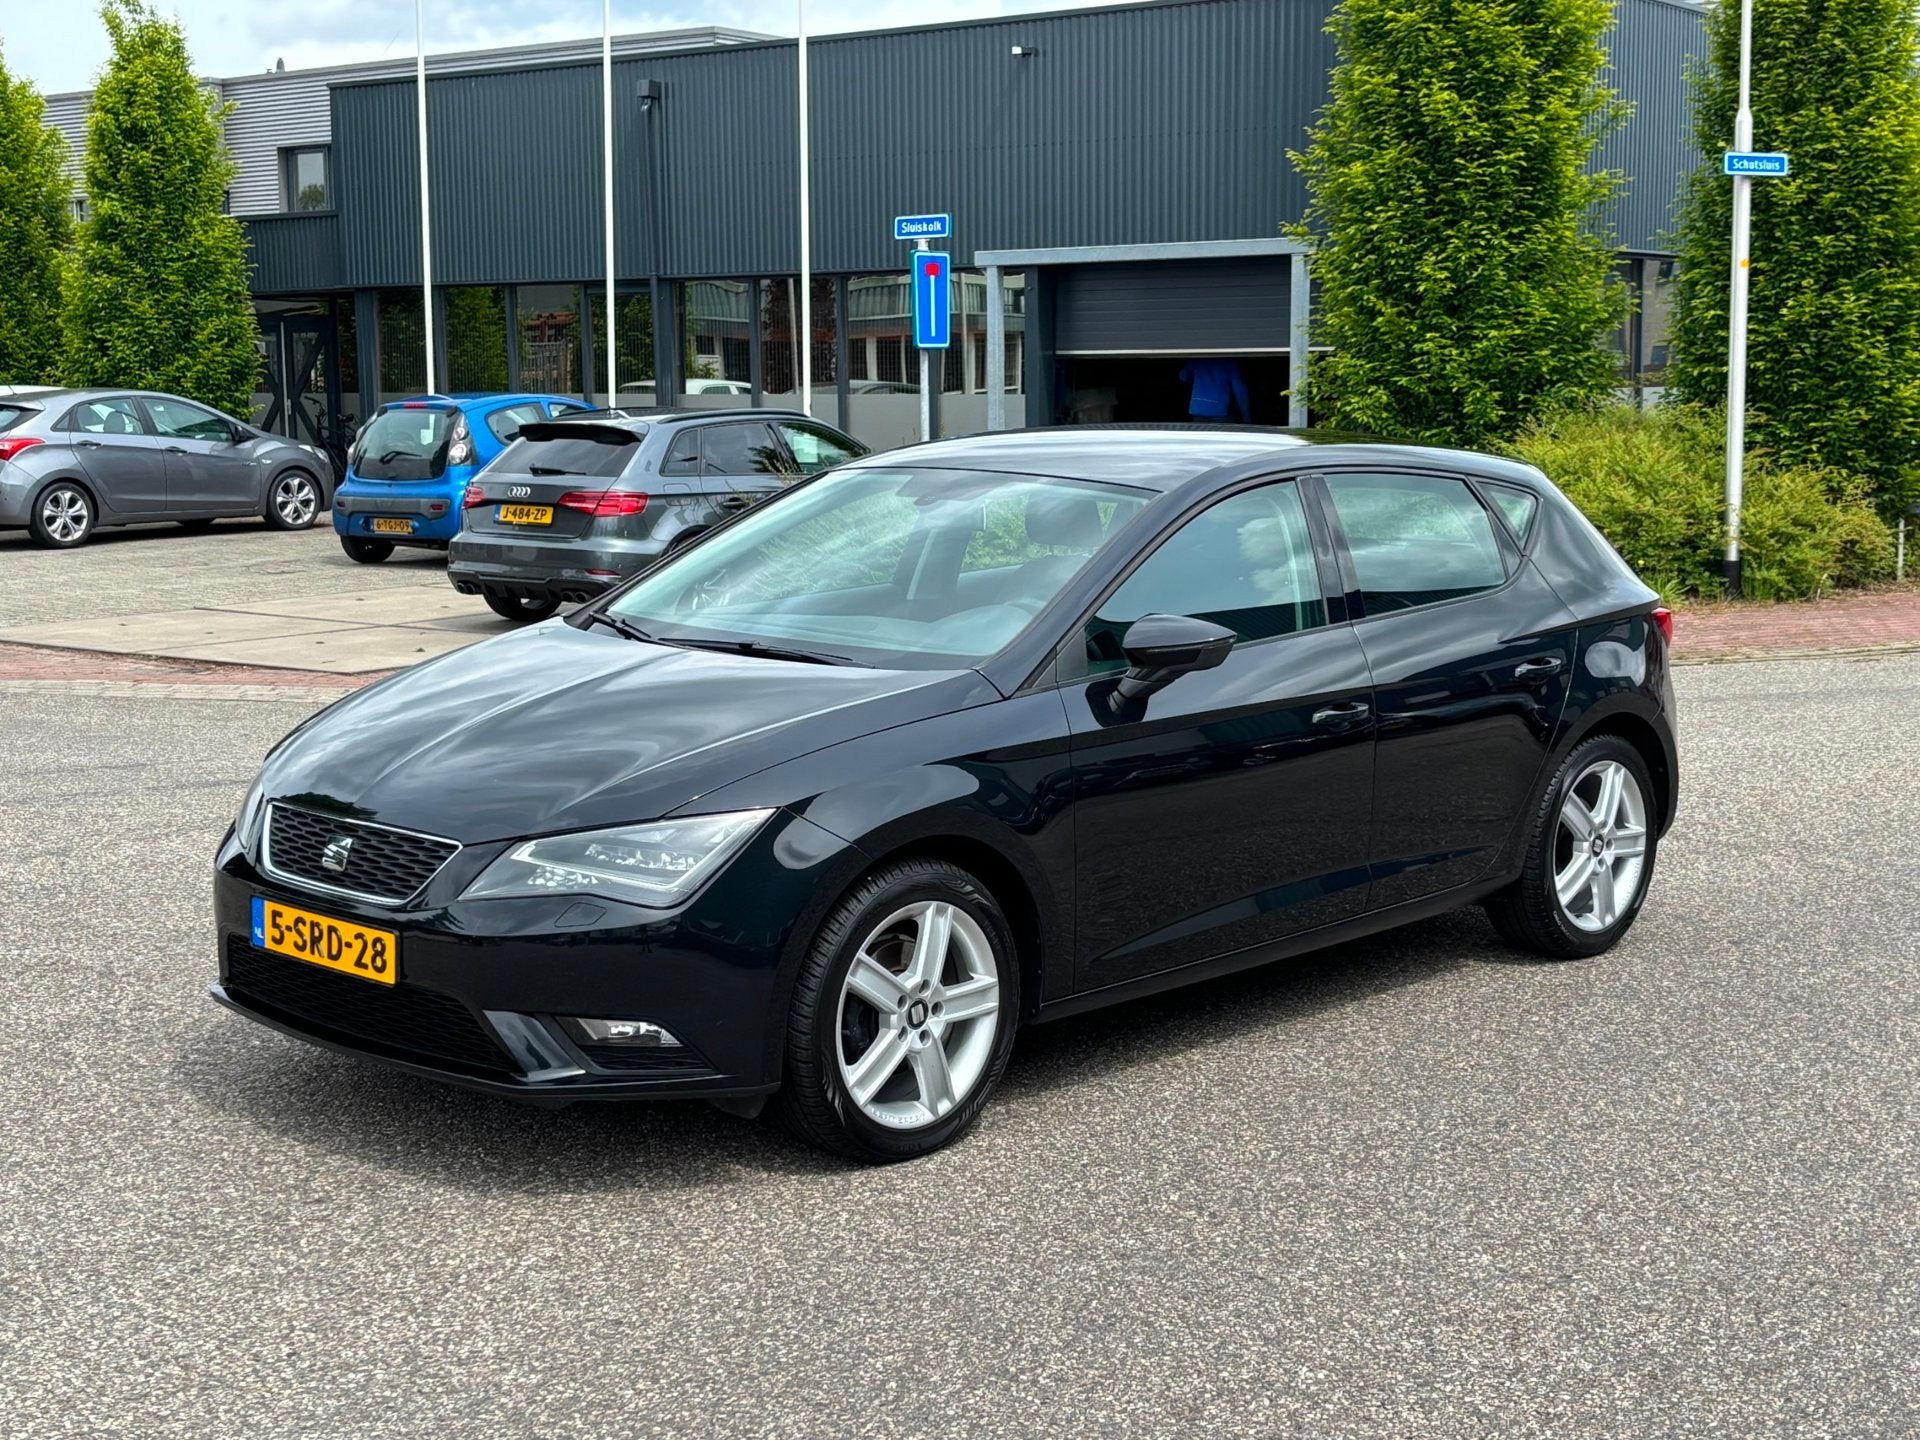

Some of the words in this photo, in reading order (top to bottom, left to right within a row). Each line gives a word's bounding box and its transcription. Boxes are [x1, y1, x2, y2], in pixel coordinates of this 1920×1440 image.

[1732, 158, 1780, 170] Schutsluis
[901, 220, 942, 234] Sluiskolk
[502, 507, 548, 521] J-484-ZP
[271, 909, 388, 974] 5-SRD-28
